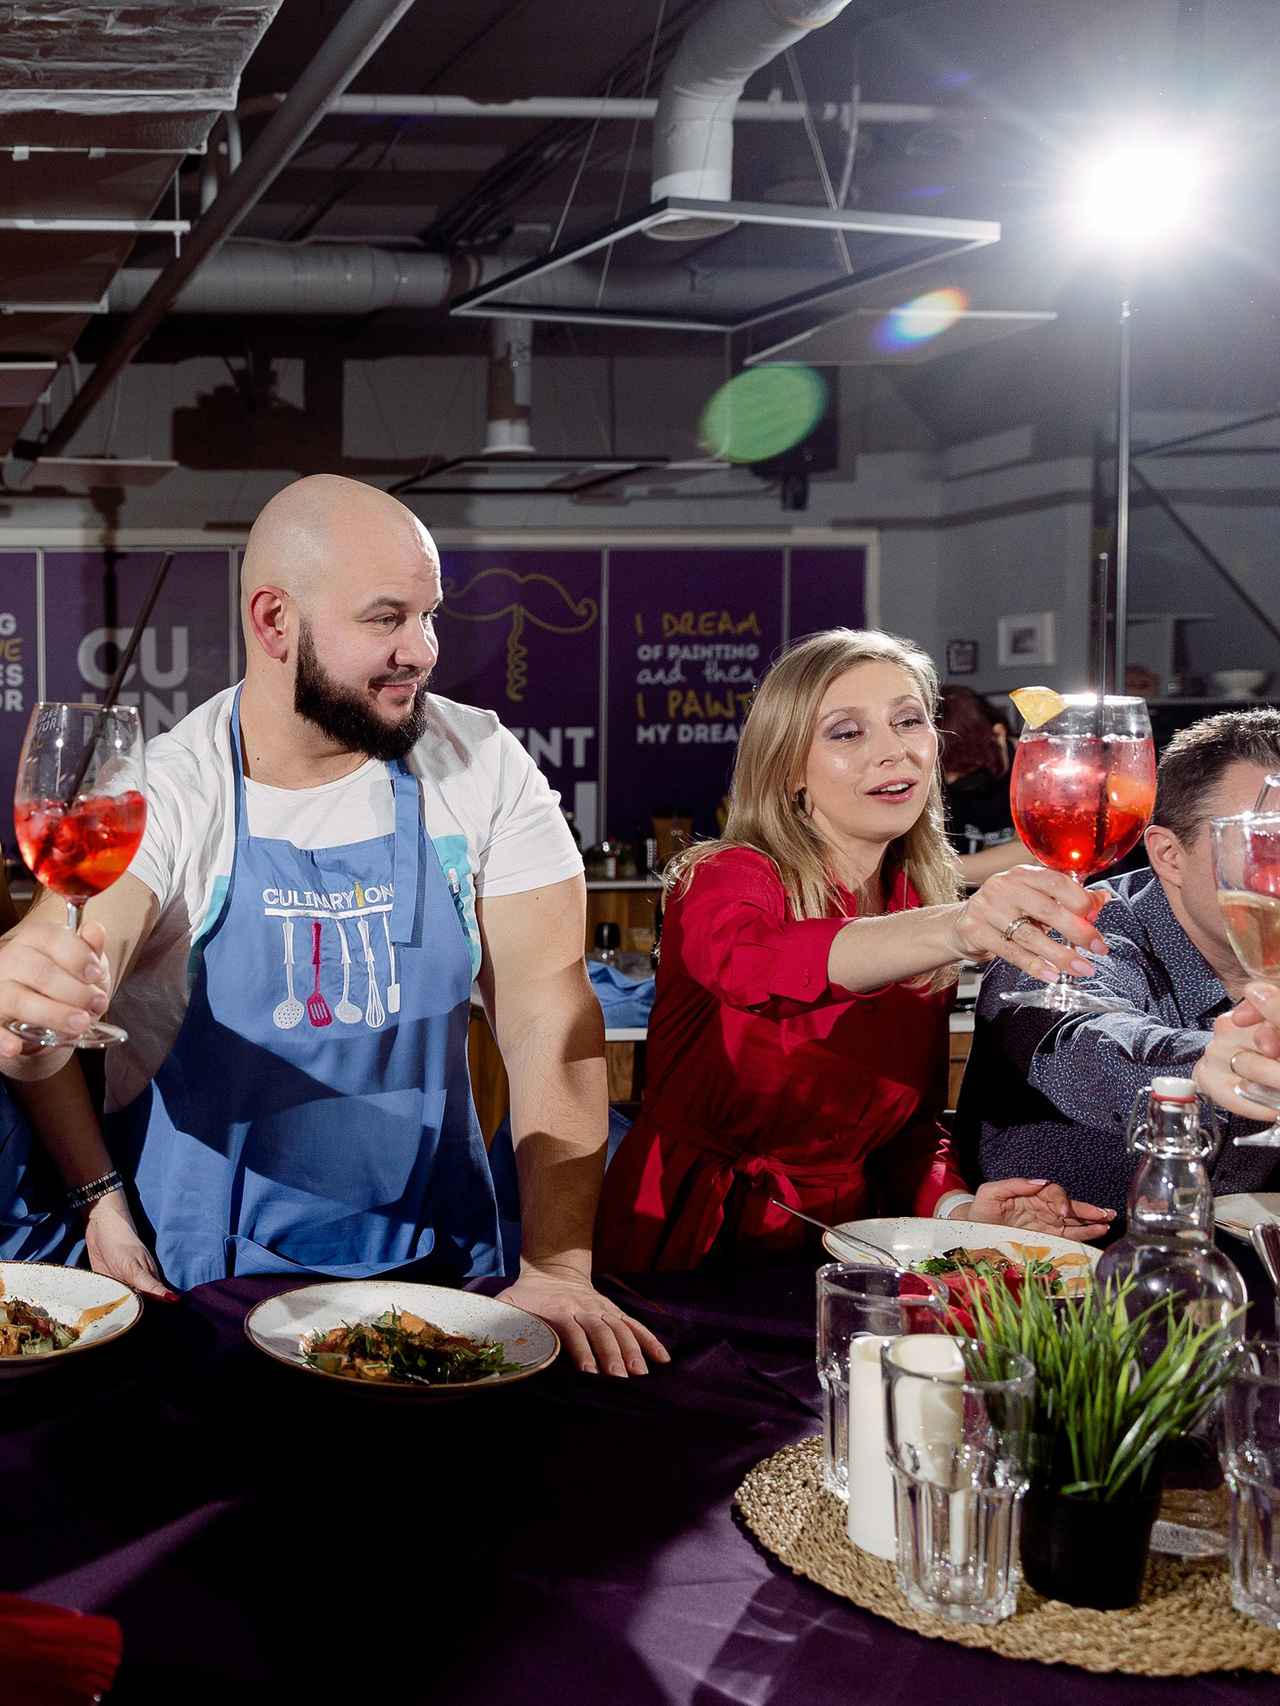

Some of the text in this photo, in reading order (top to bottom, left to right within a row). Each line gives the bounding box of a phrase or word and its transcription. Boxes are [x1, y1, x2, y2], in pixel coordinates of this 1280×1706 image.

[635, 610, 762, 638] I DREAM
[77, 626, 189, 689] CU
[636, 643, 761, 662] OF PAINTING
[636, 658, 758, 685] and then
[636, 691, 646, 719] I
[509, 726, 595, 768] NT
[636, 723, 743, 745] MY DREA
